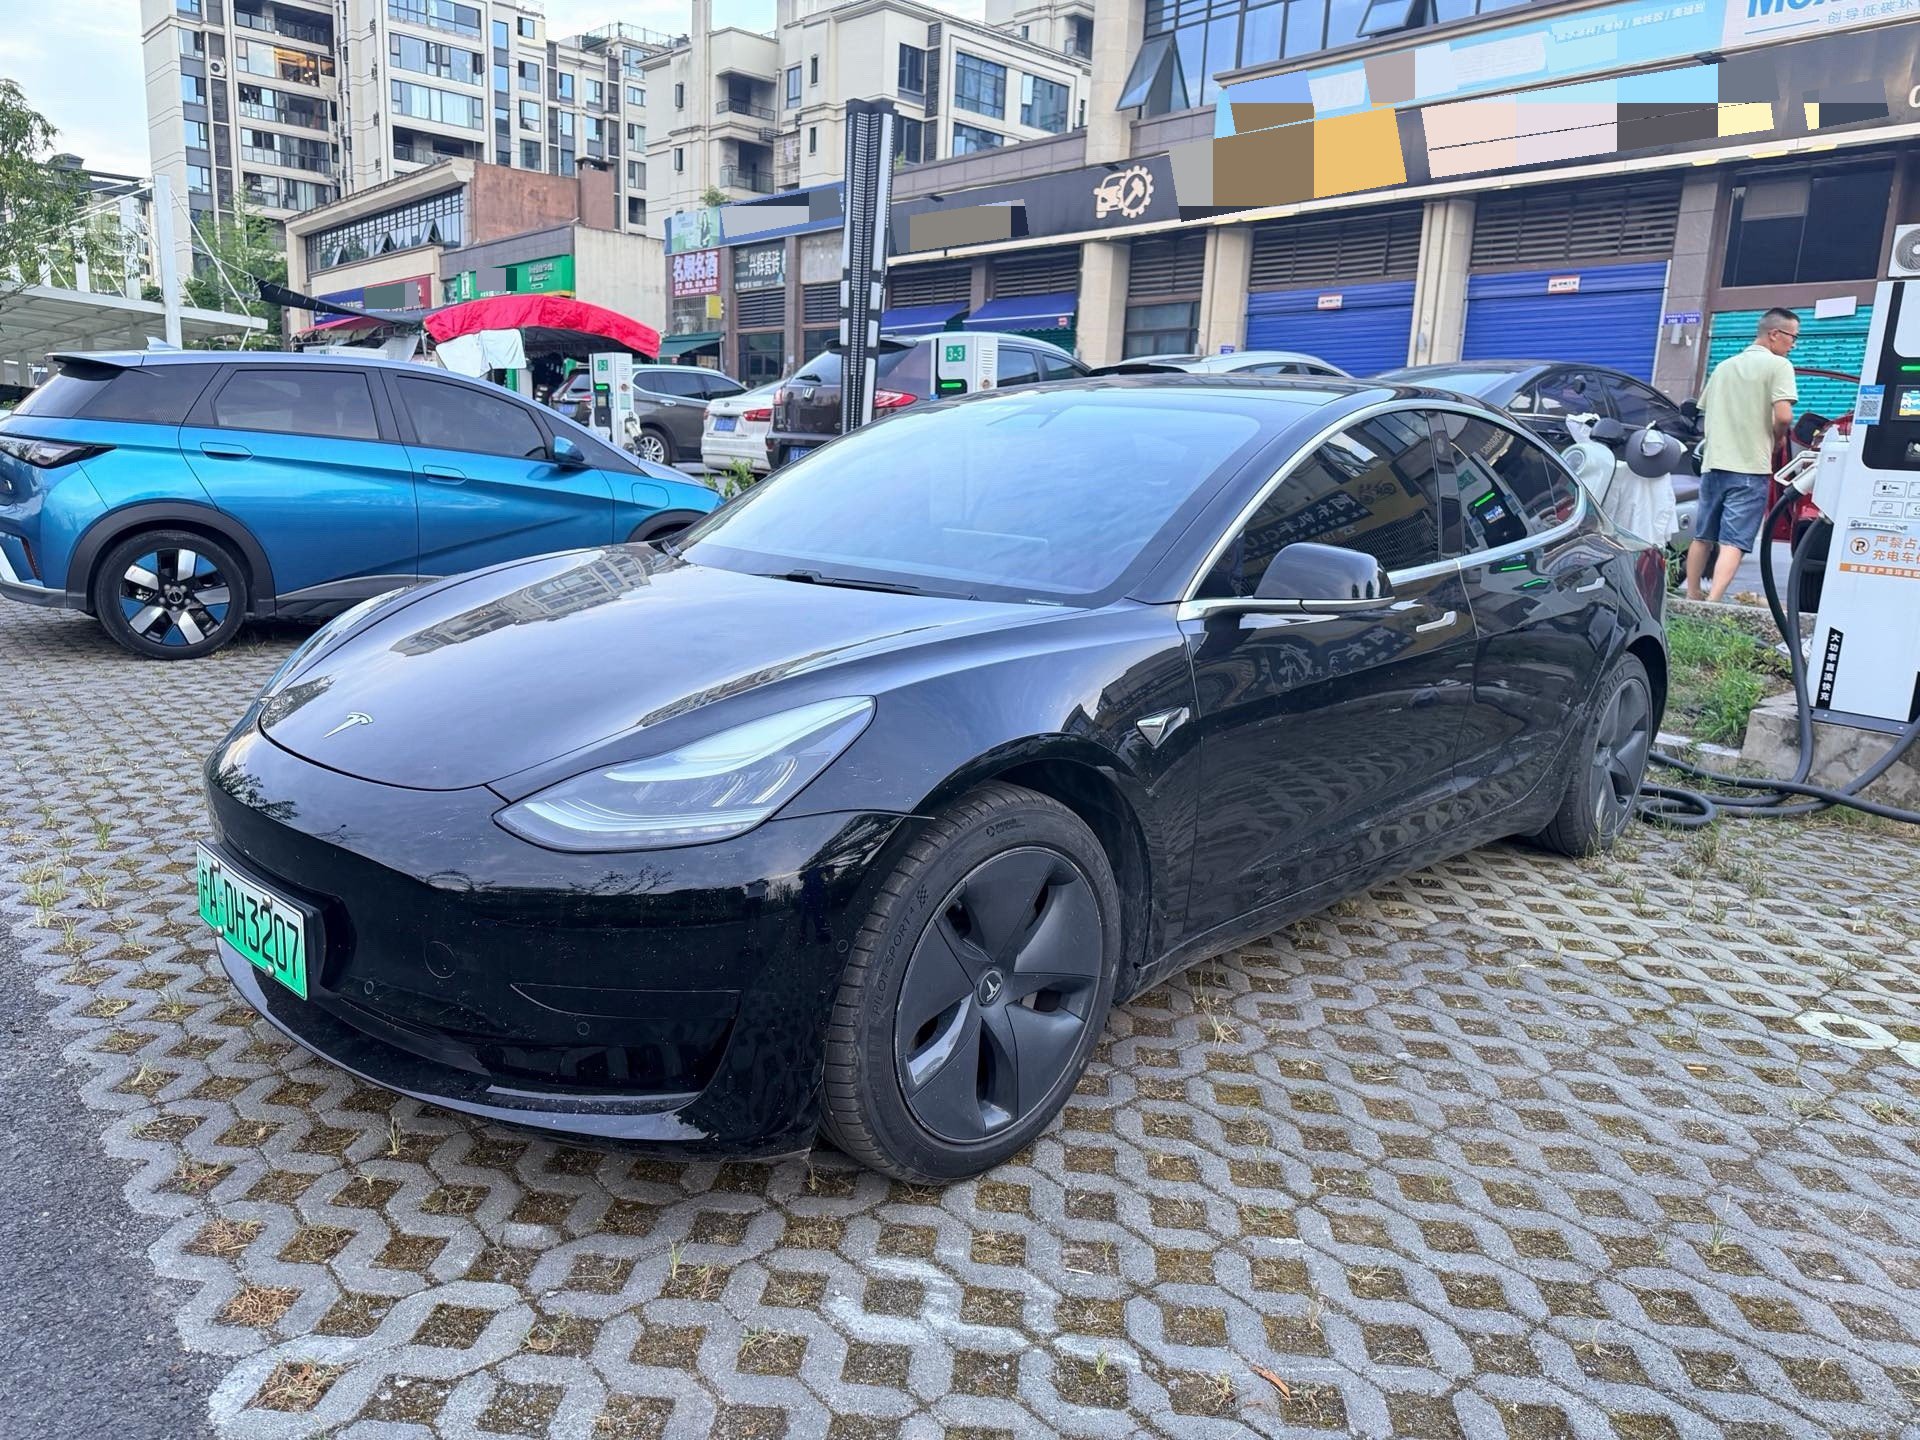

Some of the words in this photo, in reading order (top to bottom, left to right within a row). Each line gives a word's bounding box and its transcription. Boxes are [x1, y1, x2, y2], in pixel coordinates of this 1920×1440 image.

[1828, 0, 1920, 24] 创导低碳环
[947, 347, 964, 361] 3-3
[1874, 535, 1920, 549] 严禁占
[1820, 633, 1841, 701] 大功率直流快充
[872, 968, 889, 1017] PILOT
[886, 914, 912, 967] SPORT
